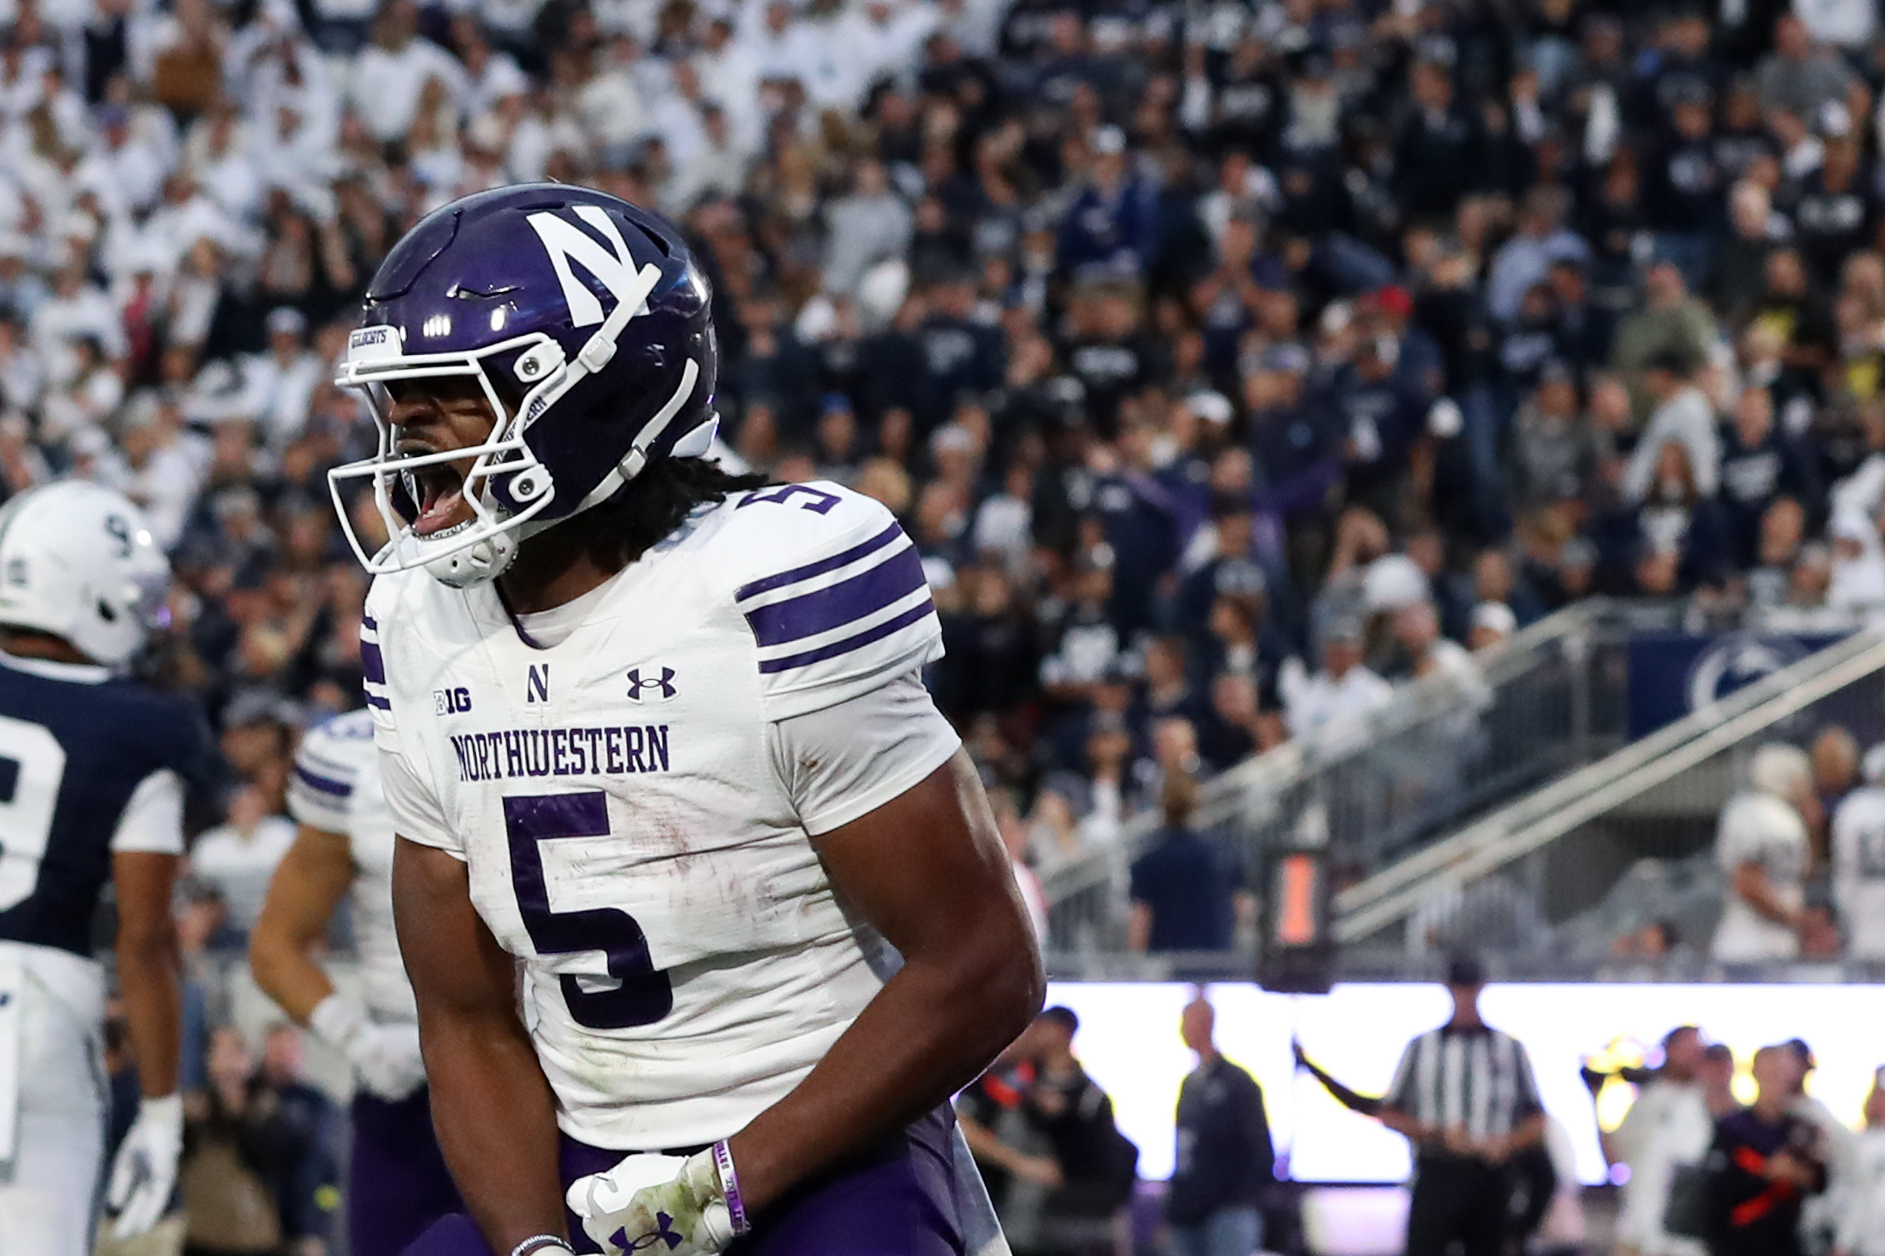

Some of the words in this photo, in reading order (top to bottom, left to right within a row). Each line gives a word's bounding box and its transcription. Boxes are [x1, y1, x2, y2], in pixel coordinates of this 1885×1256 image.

[527, 206, 649, 328] N
[527, 663, 549, 704] N
[451, 725, 670, 782] NORTHWESTERN
[503, 790, 673, 1029] 5
